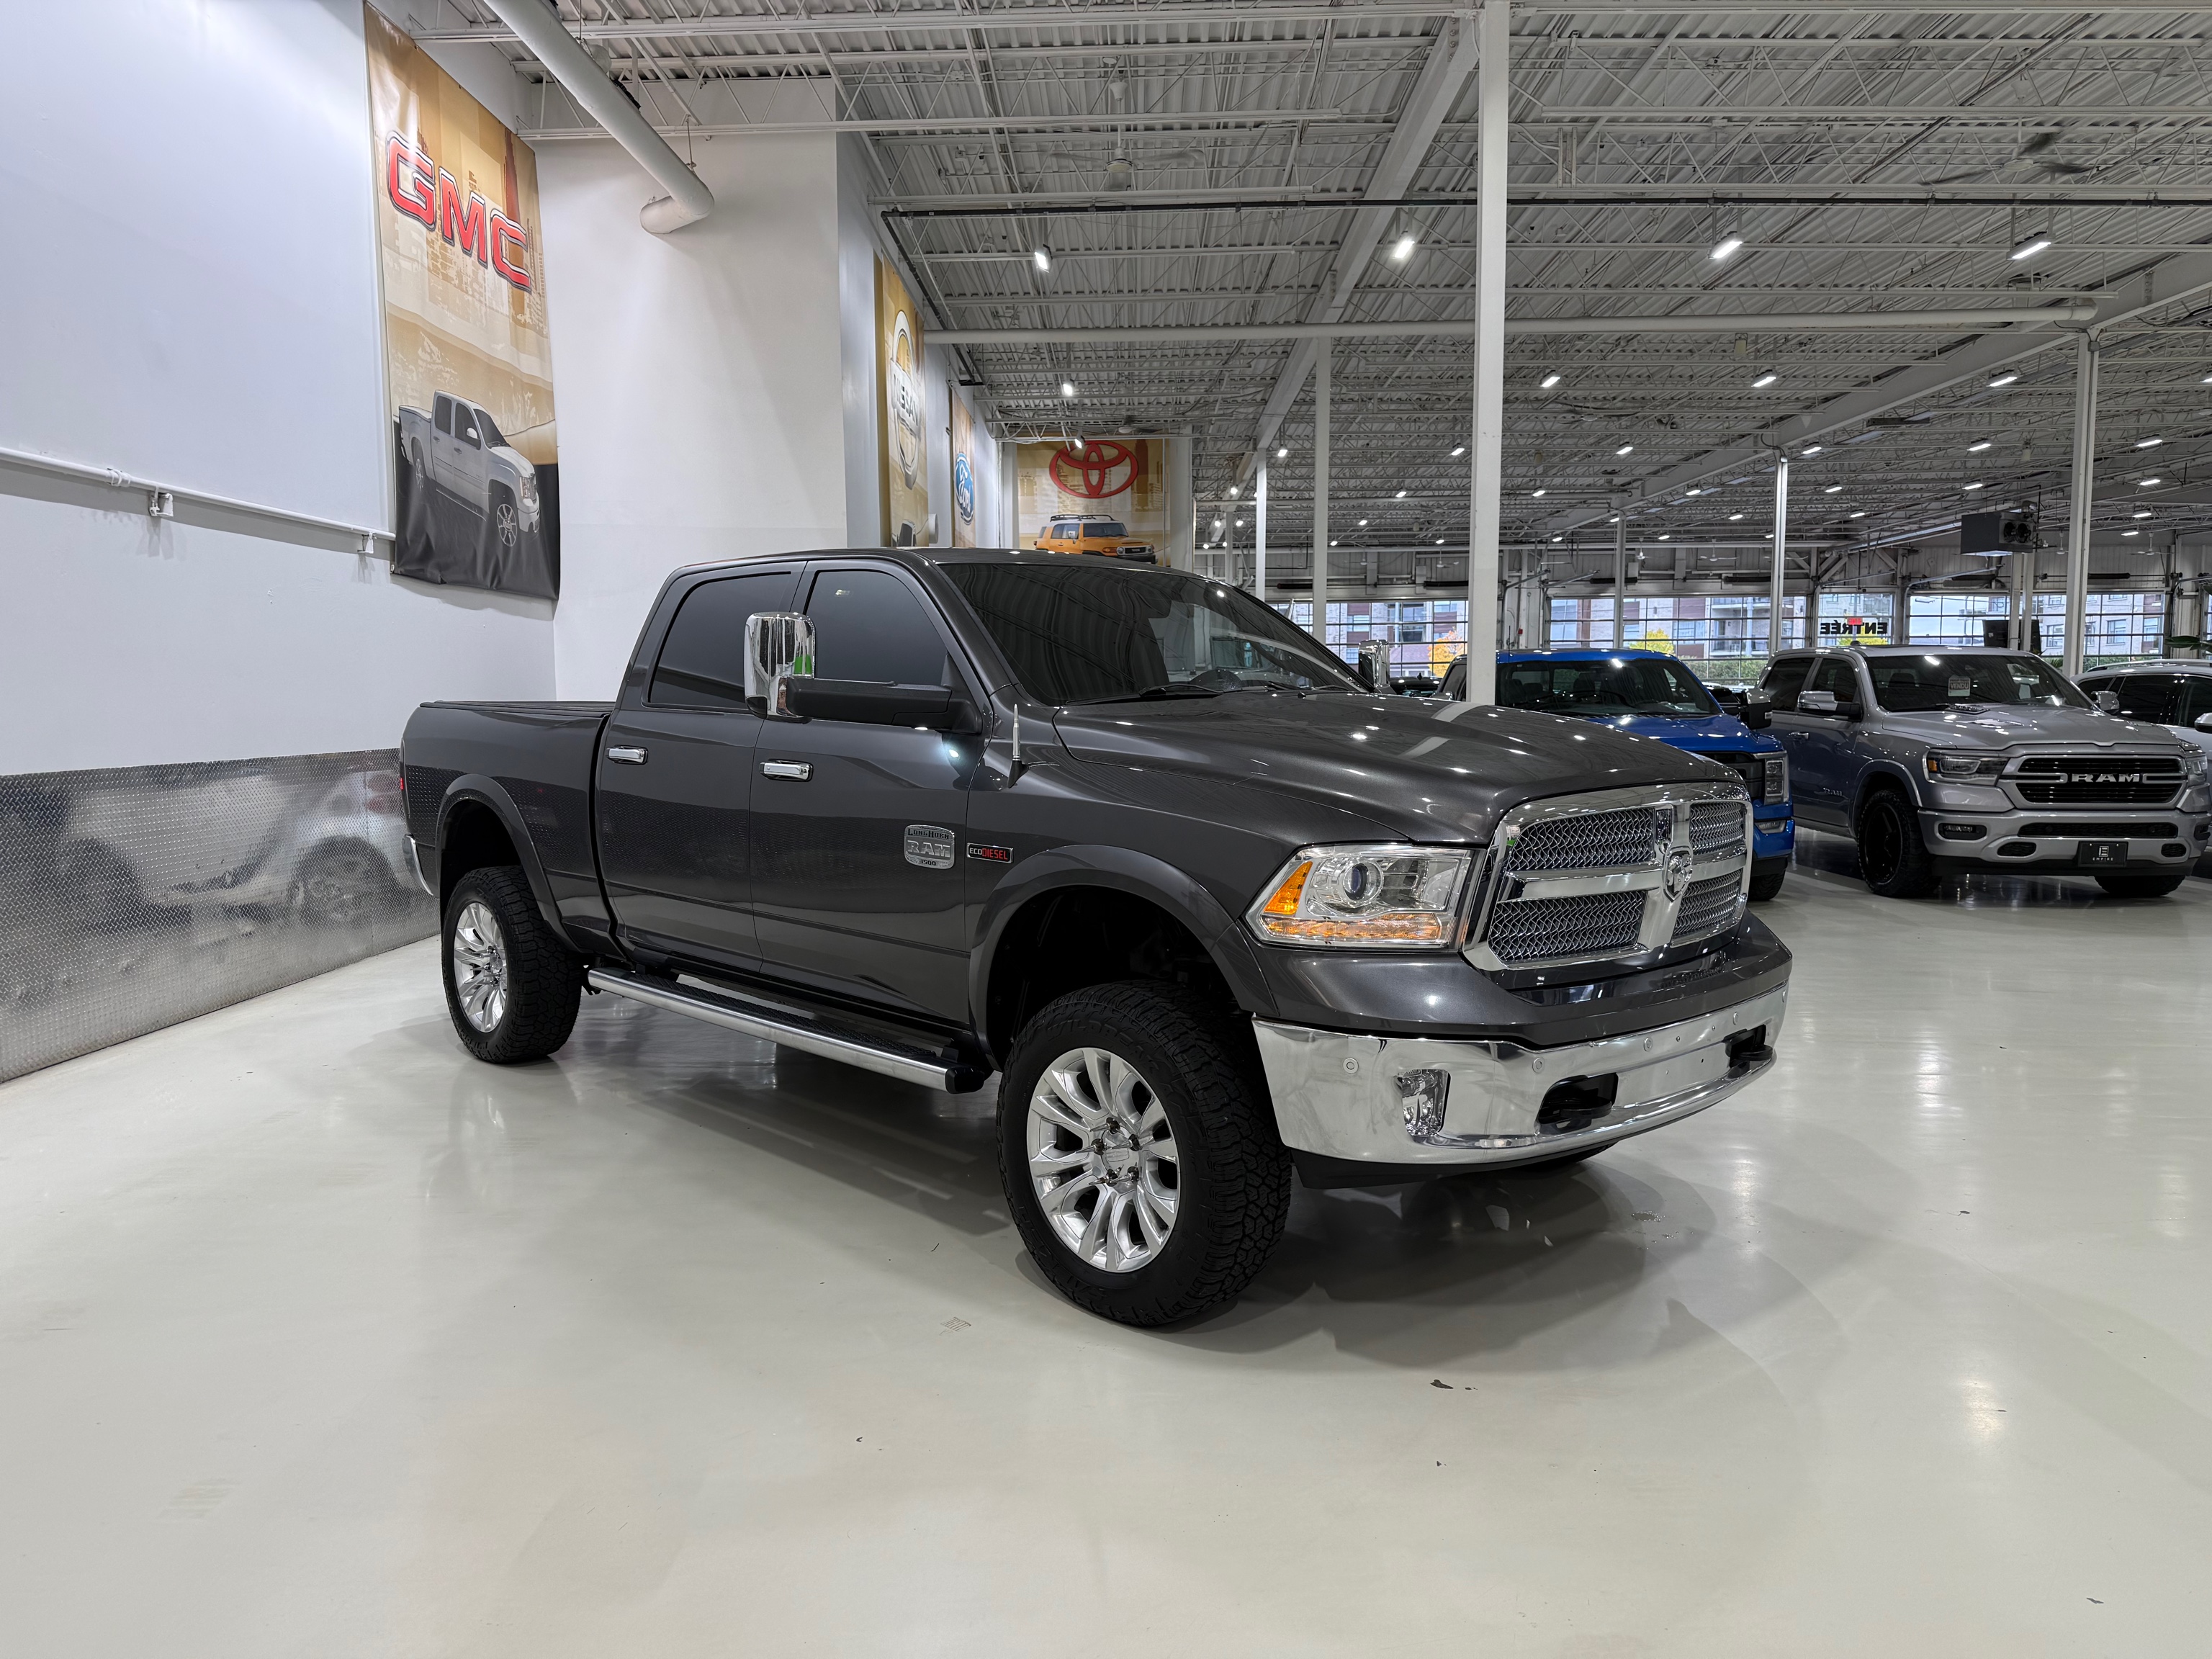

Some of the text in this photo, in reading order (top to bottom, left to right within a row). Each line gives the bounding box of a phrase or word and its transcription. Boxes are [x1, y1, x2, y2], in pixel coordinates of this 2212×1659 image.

[385, 130, 531, 295] GMC
[892, 372, 919, 427] NISSAN
[2071, 773, 2140, 783] RAM
[907, 840, 950, 858] RAM
[969, 848, 1009, 861] ECODIESEL
